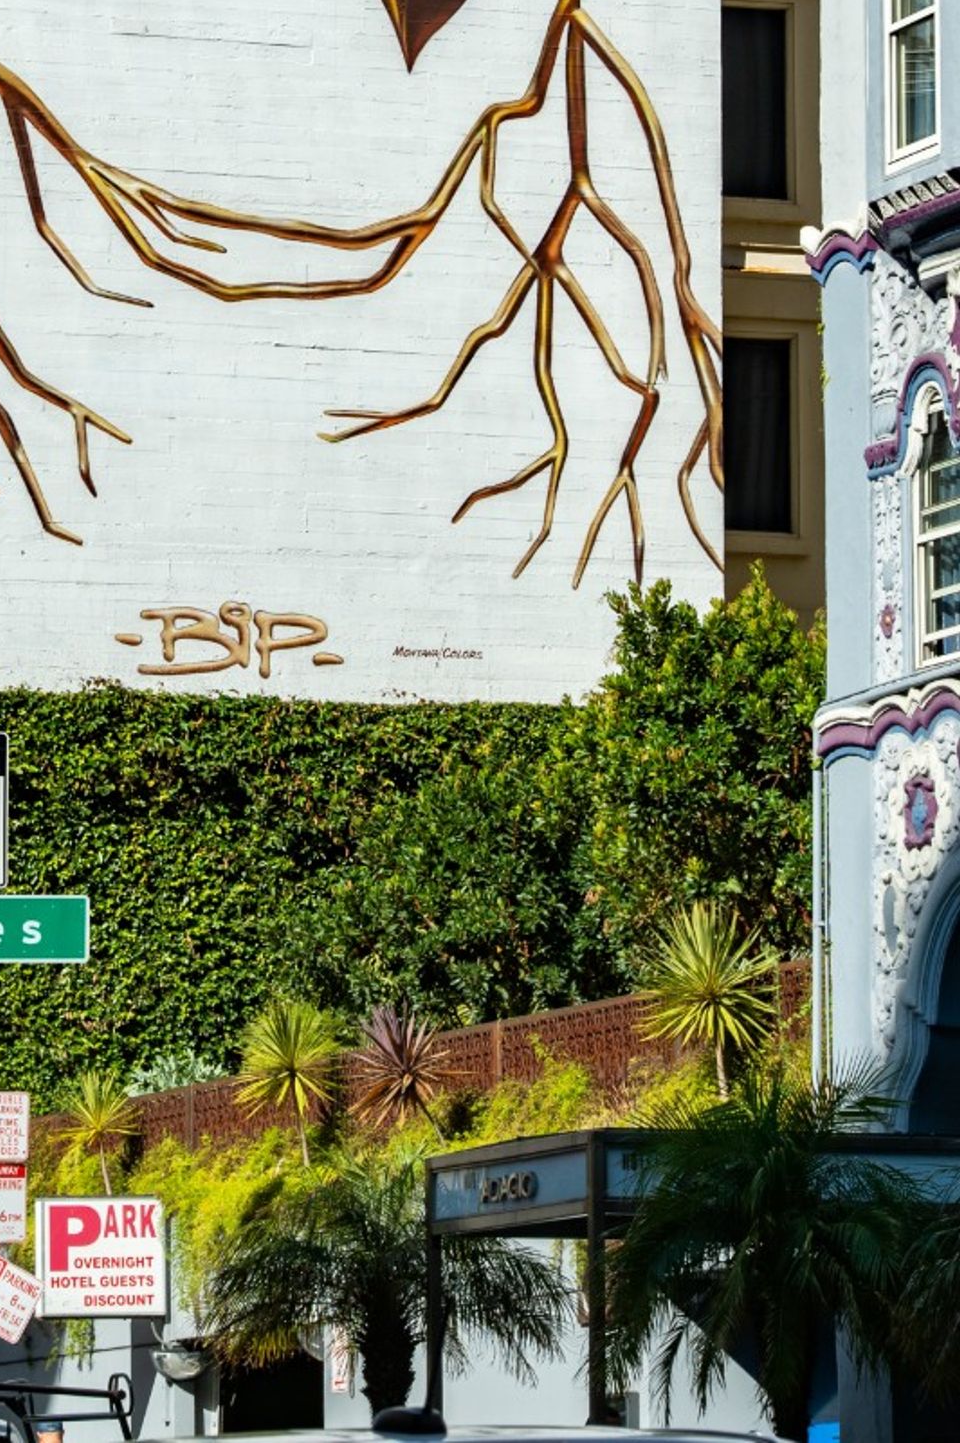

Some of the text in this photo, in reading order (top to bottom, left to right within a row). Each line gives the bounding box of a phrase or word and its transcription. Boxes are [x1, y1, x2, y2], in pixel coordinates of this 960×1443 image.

[49, 1204, 157, 1272] PARK
[73, 1256, 154, 1269] OVERNIGHT
[3, 1269, 40, 1298] PARKING
[50, 1275, 155, 1289] HOTEL GUESTS
[84, 1294, 155, 1307] DISCOUNT
